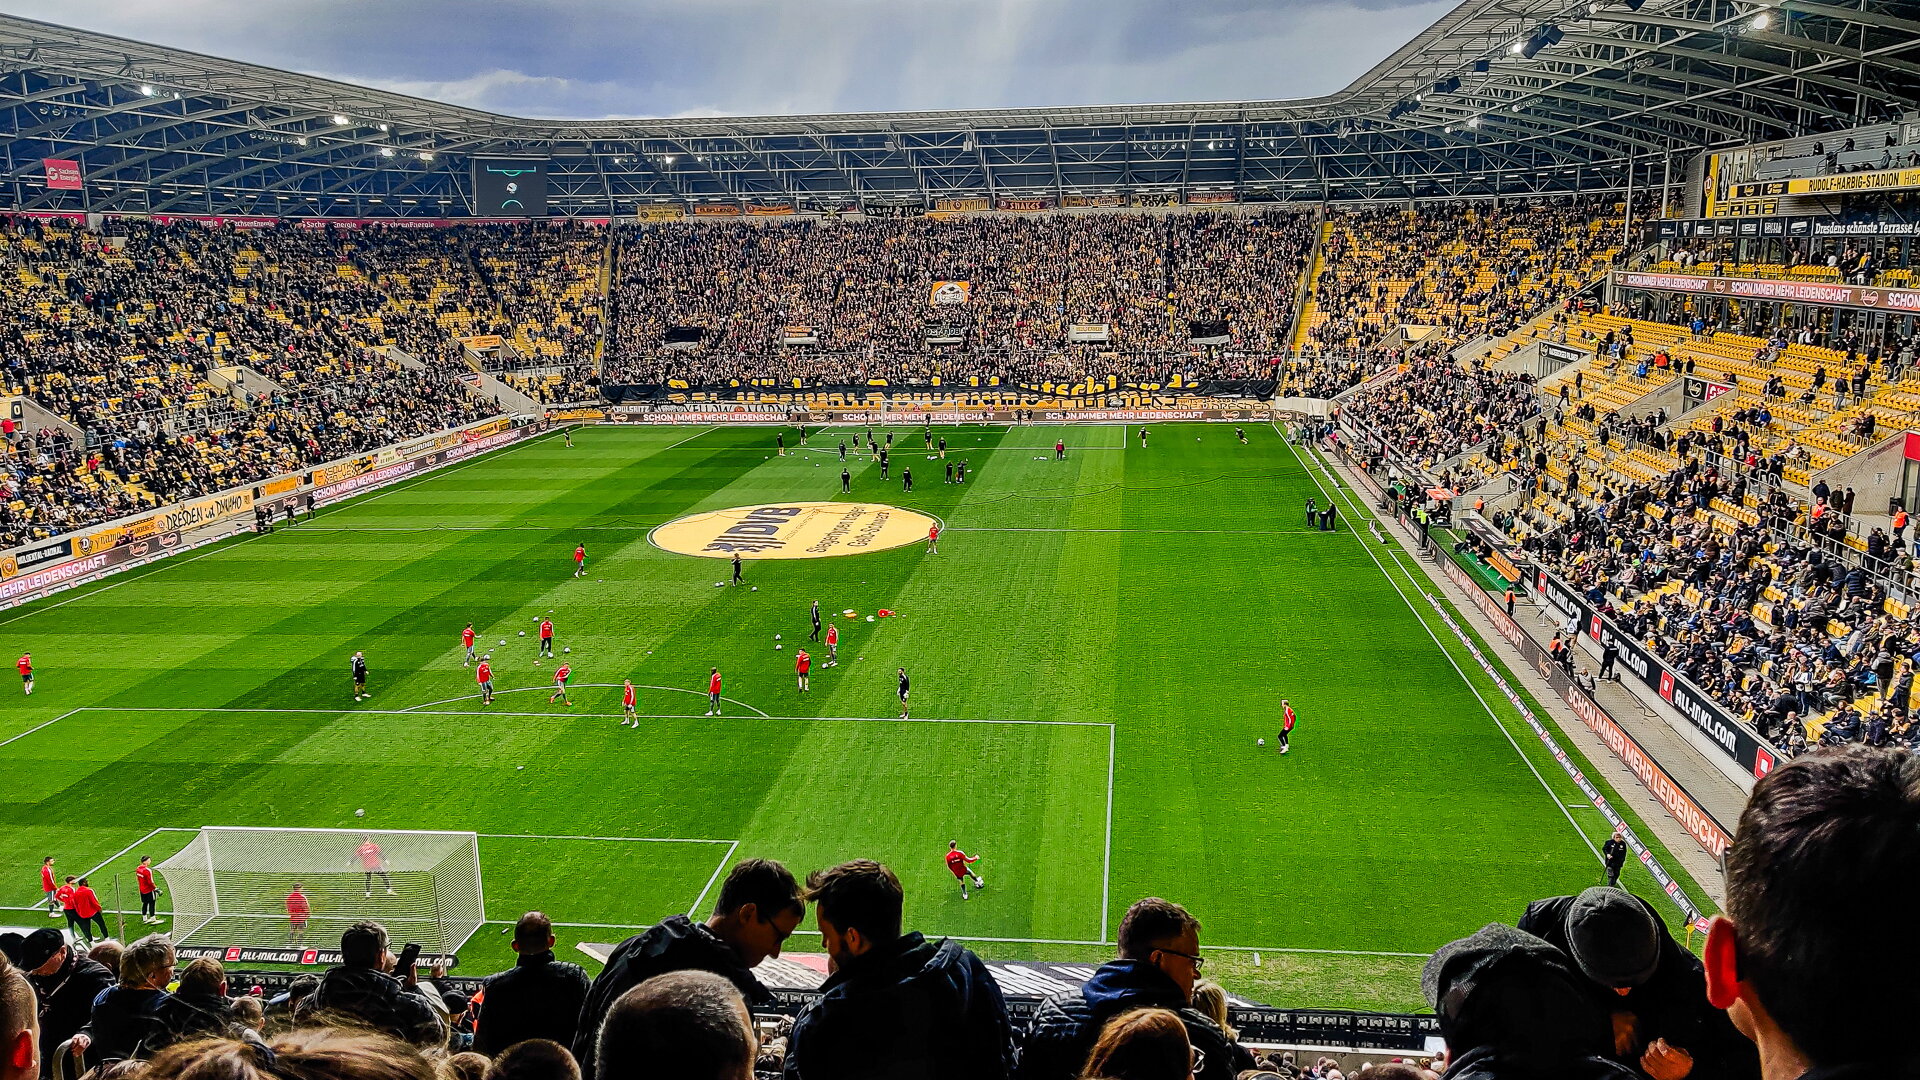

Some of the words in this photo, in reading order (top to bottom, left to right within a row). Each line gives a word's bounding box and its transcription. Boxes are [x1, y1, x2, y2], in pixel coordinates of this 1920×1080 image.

[1808, 172, 1900, 192] RUDOLF-HARBIG-STADION
[1815, 221, 1845, 234] Dresdens
[1846, 221, 1878, 234] schönste
[1879, 221, 1910, 234] Terrasse
[1731, 282, 1752, 293] SCHON
[1775, 285, 1795, 298] MEHR
[1796, 286, 1852, 302] LEIDENSCHAFT
[1887, 292, 1920, 308] SCHON
[1079, 412, 1107, 420] IMMER
[1137, 411, 1204, 419] LEIDENSCHAFT
[313, 485, 336, 500] SCHON
[336, 479, 357, 493] IMMER
[357, 474, 375, 487] MEHR
[374, 461, 415, 482] LEIDENSCHAFT
[166, 507, 203, 531] DRESDEN
[724, 506, 802, 536] DVB
[0, 579, 27, 599] EHR
[27, 554, 107, 590] LEIDENSCHAFT
[1675, 690, 1737, 753] ALL-INKL.COM
[1568, 685, 1596, 730] SCHON
[1594, 710, 1626, 759] IMMER
[1625, 740, 1653, 790] MEHR
[1652, 767, 1731, 858] LEIDENSCHA
[241, 951, 298, 962] ALL-INKL.COM
